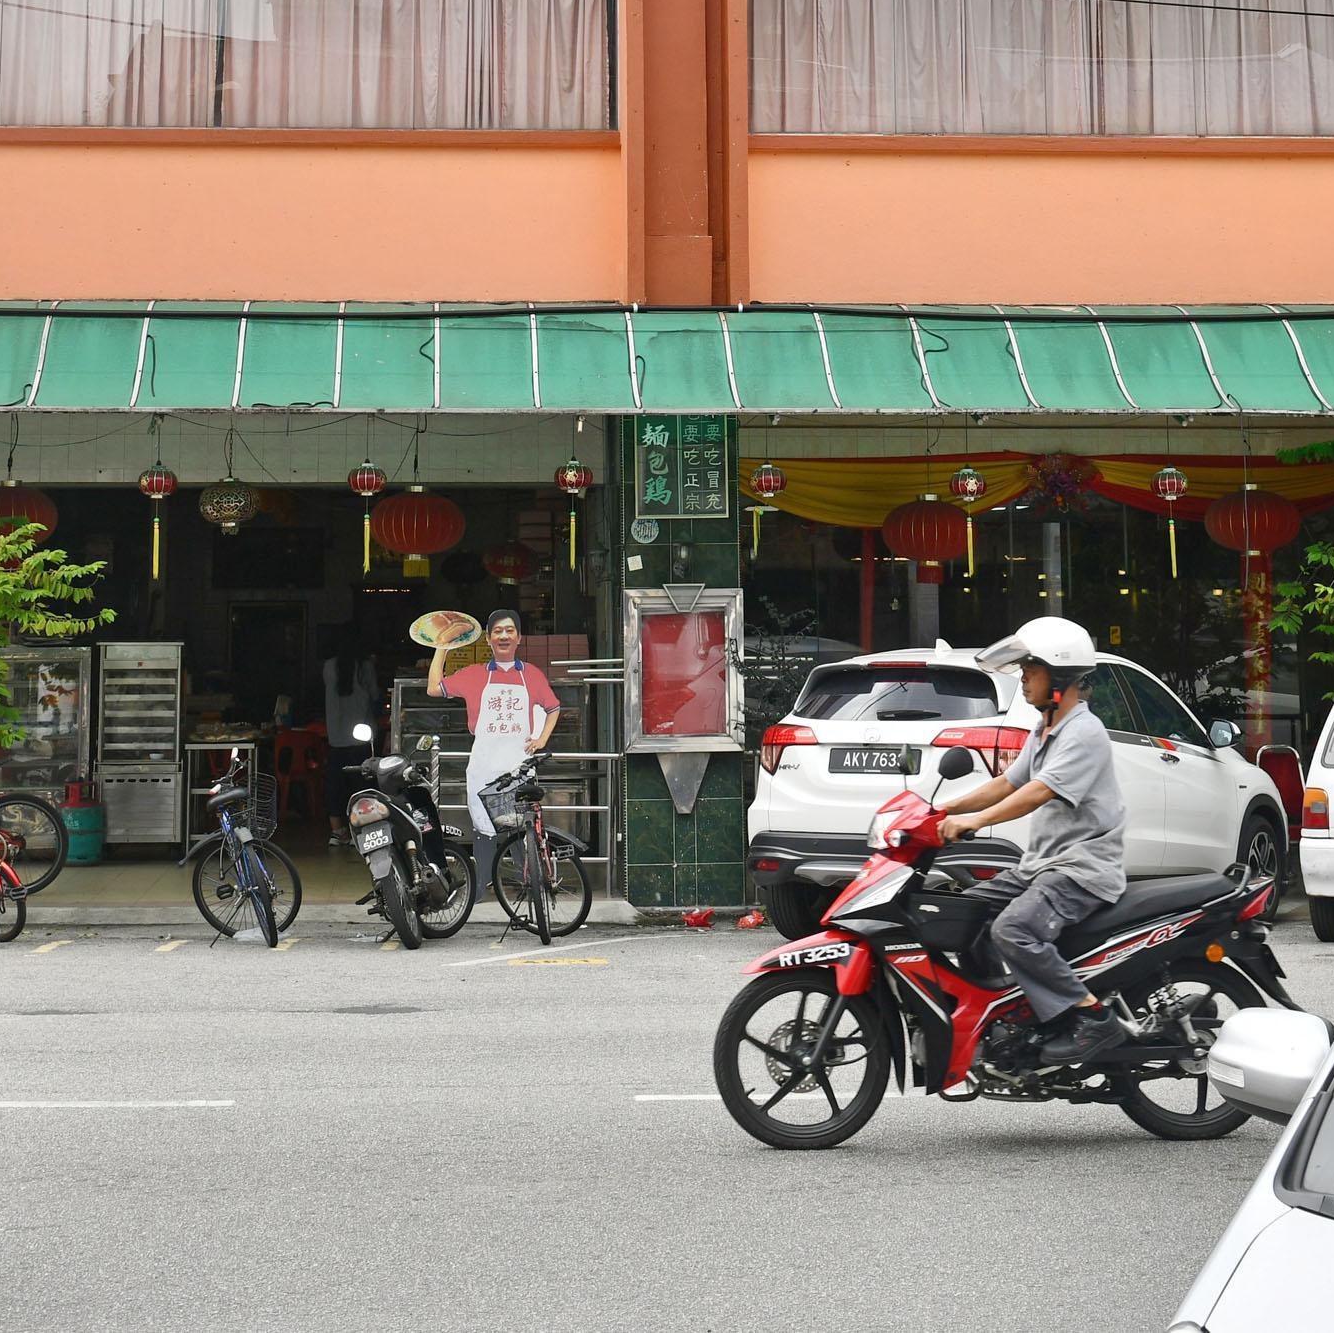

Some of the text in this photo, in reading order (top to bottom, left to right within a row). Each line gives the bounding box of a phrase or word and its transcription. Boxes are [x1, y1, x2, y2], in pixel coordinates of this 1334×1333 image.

[683, 415, 701, 511] 要吃正宗
[704, 415, 723, 511] 要吃冒充
[843, 751, 869, 767] AKY
[363, 835, 389, 851] 5003
[365, 829, 384, 842] AGW
[884, 943, 923, 951] HONDA
